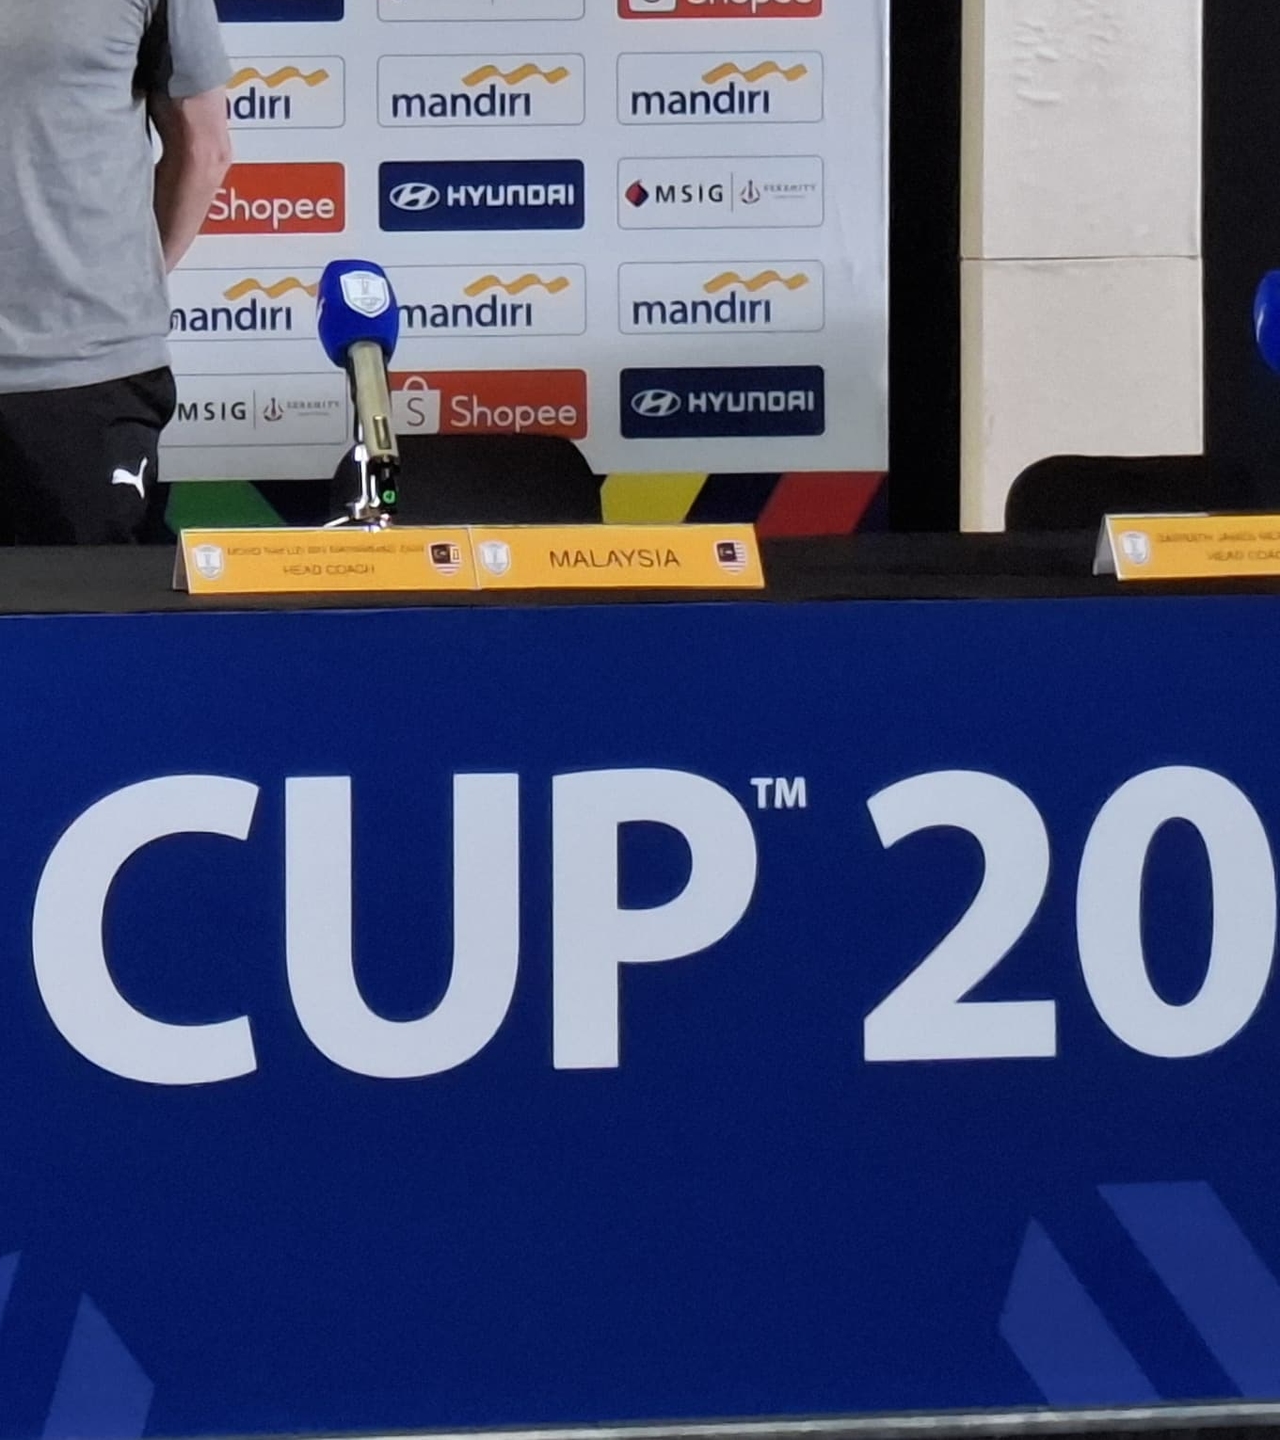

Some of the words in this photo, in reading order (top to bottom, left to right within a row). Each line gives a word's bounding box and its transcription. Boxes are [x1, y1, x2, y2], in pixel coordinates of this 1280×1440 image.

[227, 86, 291, 120] diri
[393, 84, 530, 117] mandiri
[632, 82, 769, 114] mandiri
[448, 185, 574, 206] HYUNDAI
[656, 184, 722, 202] MSIG
[208, 187, 335, 230] Shopee
[399, 295, 532, 329] mandiri
[633, 295, 770, 324] mandiri
[178, 402, 246, 420] MSIG
[451, 395, 576, 431] Shopee
[689, 391, 814, 412] HYUNDAI
[550, 549, 679, 567] MALAYSIA
